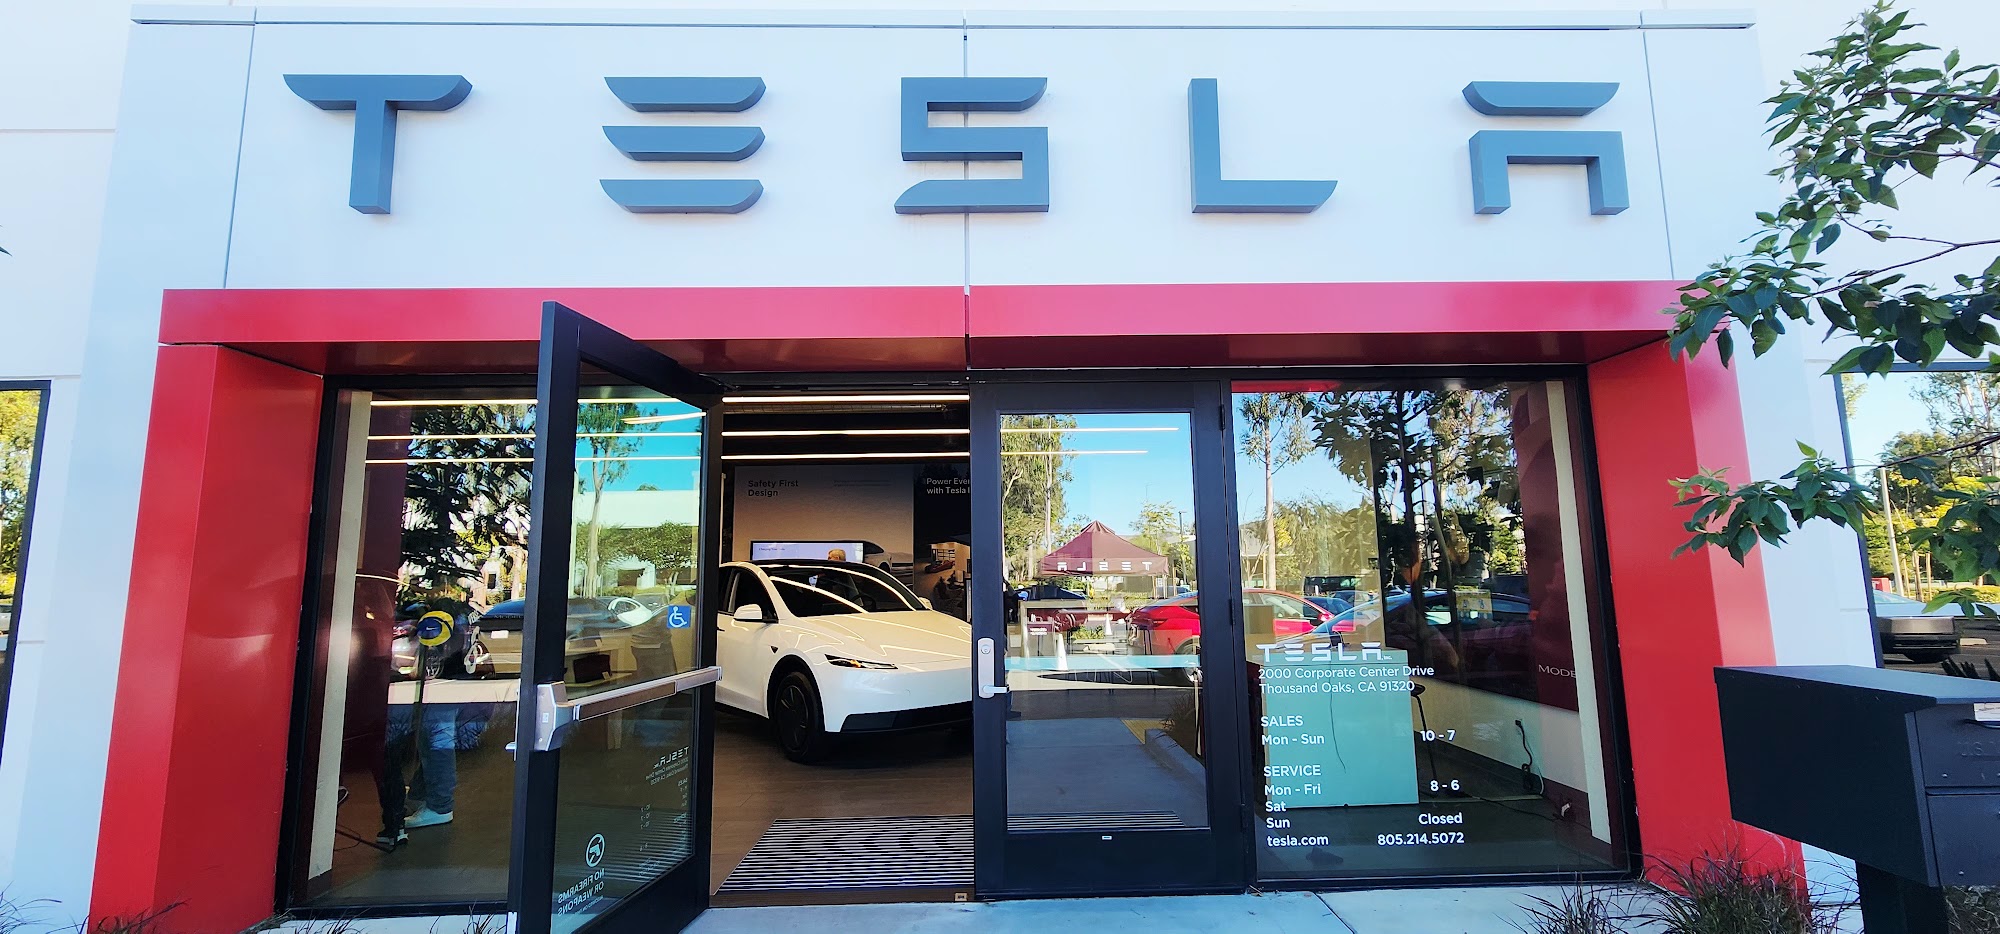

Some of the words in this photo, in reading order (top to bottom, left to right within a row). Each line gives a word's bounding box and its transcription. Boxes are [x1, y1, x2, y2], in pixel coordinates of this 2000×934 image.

[283, 73, 1630, 215] TESLA
[748, 479, 776, 489] Safety
[779, 479, 799, 487] First
[926, 477, 952, 485] Power
[748, 488, 779, 498] Design
[926, 486, 944, 495] with
[945, 486, 967, 494] Tesla
[1258, 668, 1292, 680] 2000
[1295, 667, 1356, 681] Corporate
[1359, 666, 1399, 678] Center
[1402, 665, 1435, 677] Drive
[1258, 682, 1319, 694] Thousand
[1321, 681, 1355, 694] Oaks,
[1358, 681, 1377, 692] CA
[1379, 680, 1415, 692] 91320
[1260, 715, 1304, 727] SALES
[1262, 734, 1289, 746] Mon
[1300, 733, 1325, 744] Sun
[1420, 730, 1435, 741] 10
[1447, 729, 1456, 741] 7
[1264, 765, 1321, 777] SERVICE
[1264, 784, 1292, 796] Mon
[1304, 783, 1321, 795] Fri
[1430, 780, 1439, 791] 8
[1450, 779, 1459, 791] 6
[1266, 800, 1287, 812] Sat
[1266, 817, 1290, 828] Sun
[1418, 813, 1463, 825] Closed
[1267, 835, 1329, 846] tesla.com
[1377, 833, 1465, 846] 805.214.5072
